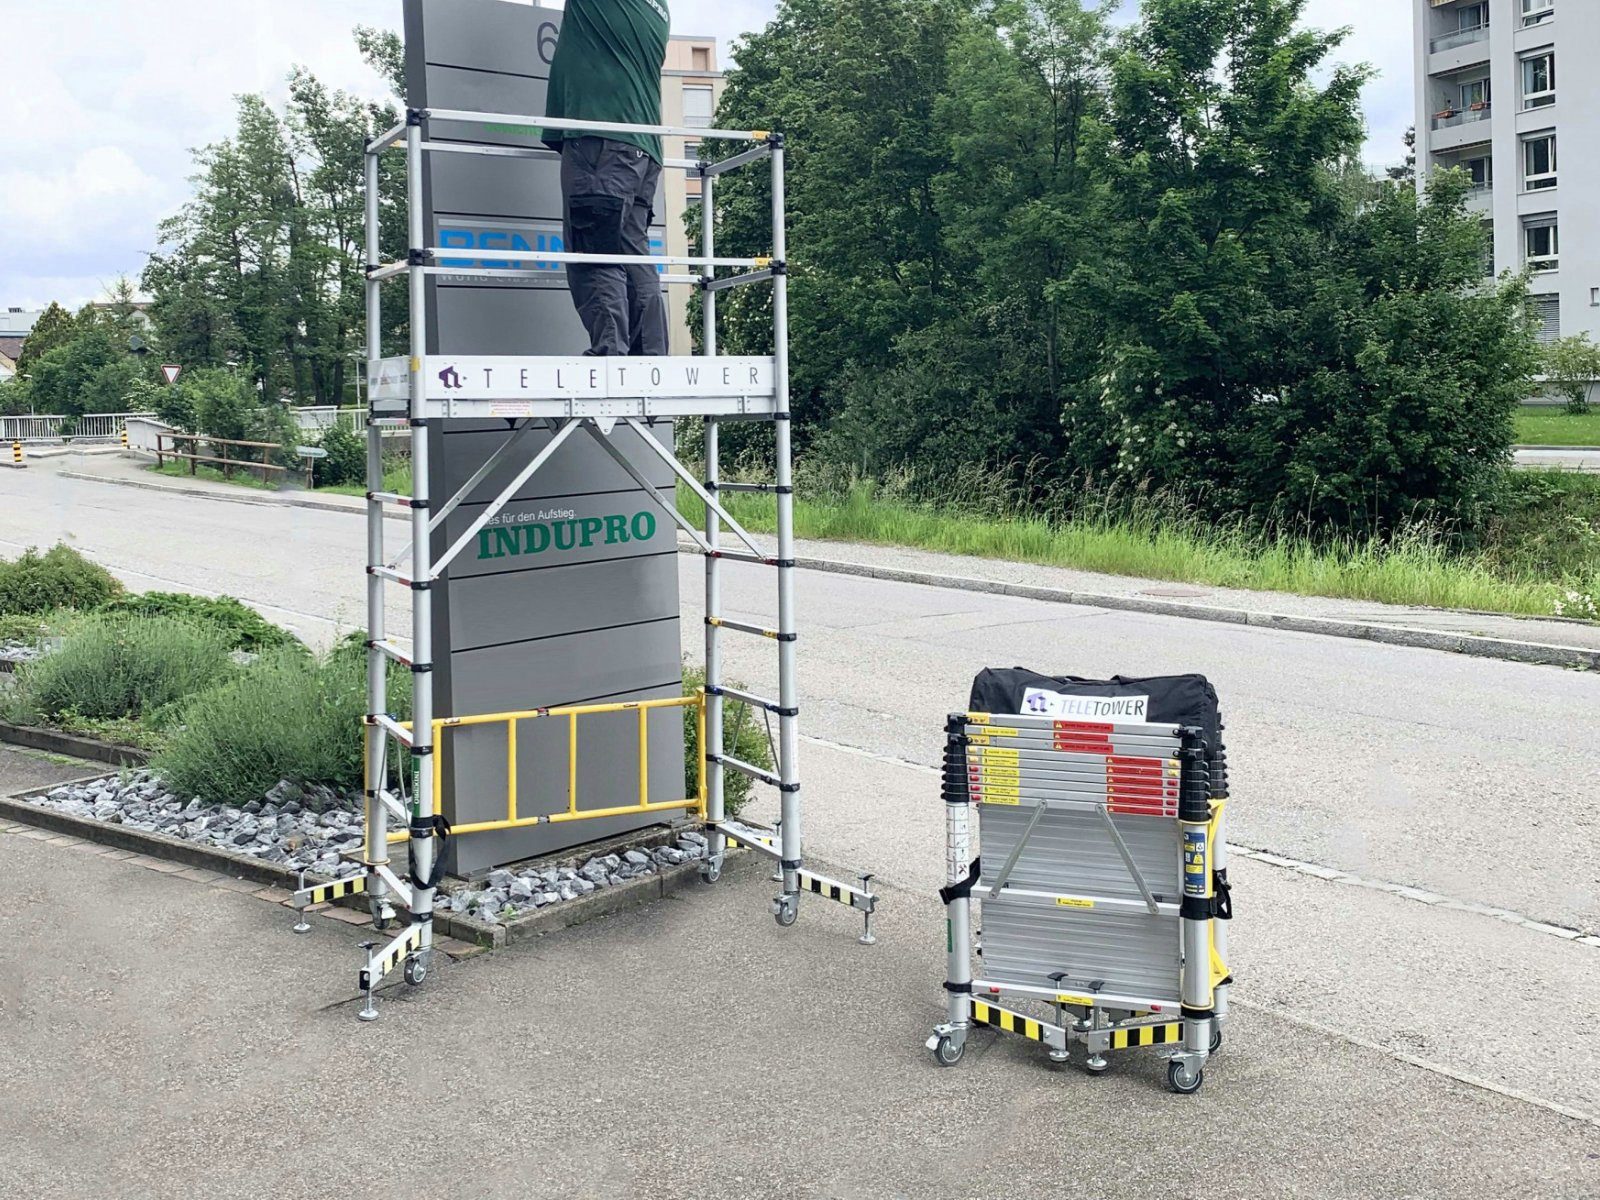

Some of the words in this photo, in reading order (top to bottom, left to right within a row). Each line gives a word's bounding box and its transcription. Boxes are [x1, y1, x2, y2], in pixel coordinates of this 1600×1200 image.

[537, 22, 558, 64] 6
[483, 367, 758, 388] TELETOWER
[502, 513, 515, 524] für
[518, 512, 535, 522] den
[477, 511, 656, 560] INDUPRO
[1061, 699, 1144, 716] TELETOWER
